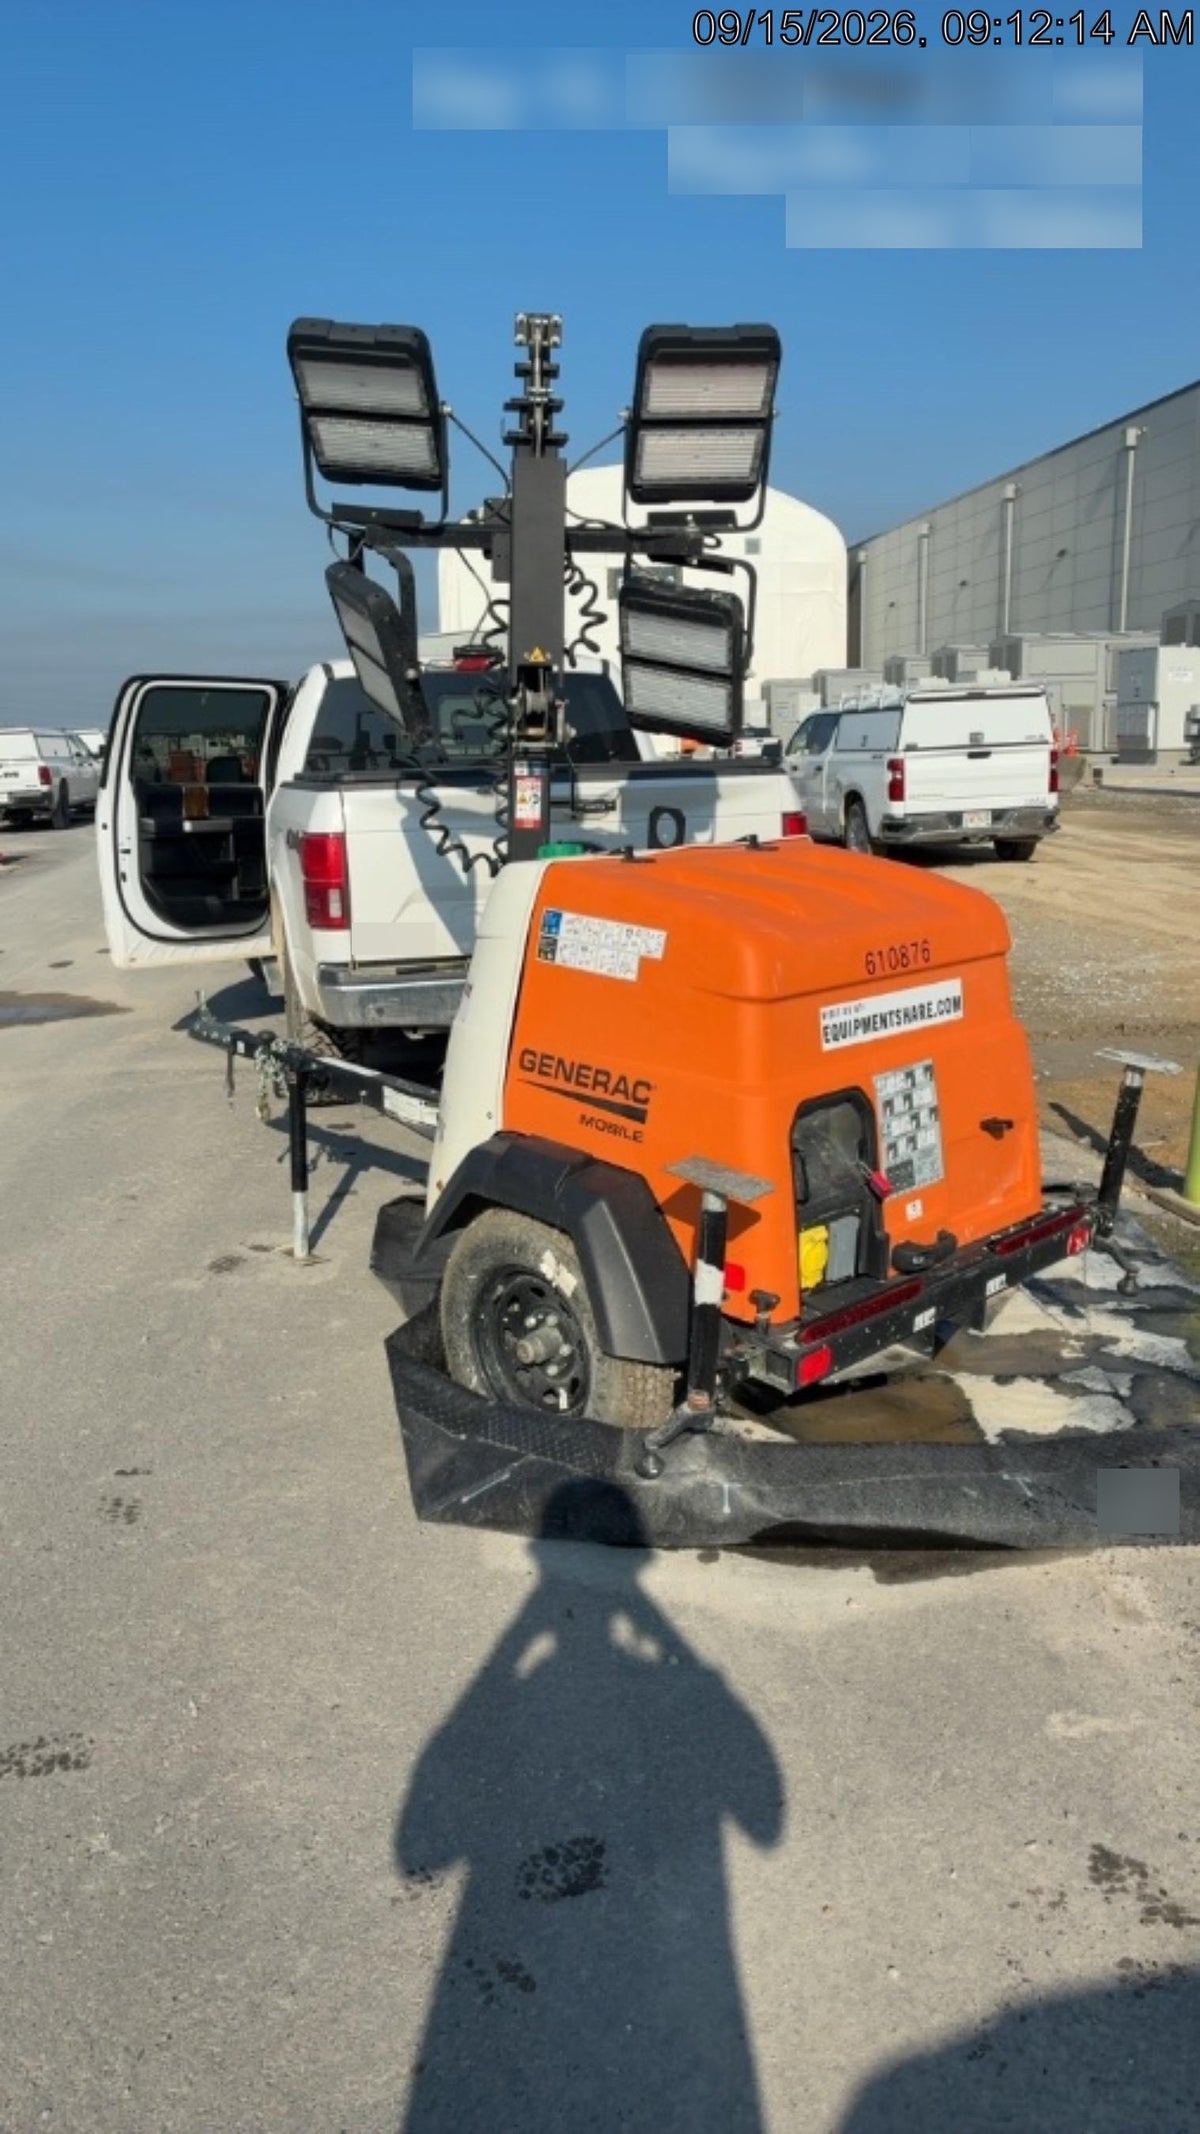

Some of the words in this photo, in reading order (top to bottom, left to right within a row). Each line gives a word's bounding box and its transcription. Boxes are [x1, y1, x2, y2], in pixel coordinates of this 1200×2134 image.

[865, 939, 931, 976] 610876
[822, 995, 962, 1044] EQUIPMENTSHARE.COM
[519, 1047, 652, 1106] GENERAC
[579, 1114, 644, 1143] MOBILE
